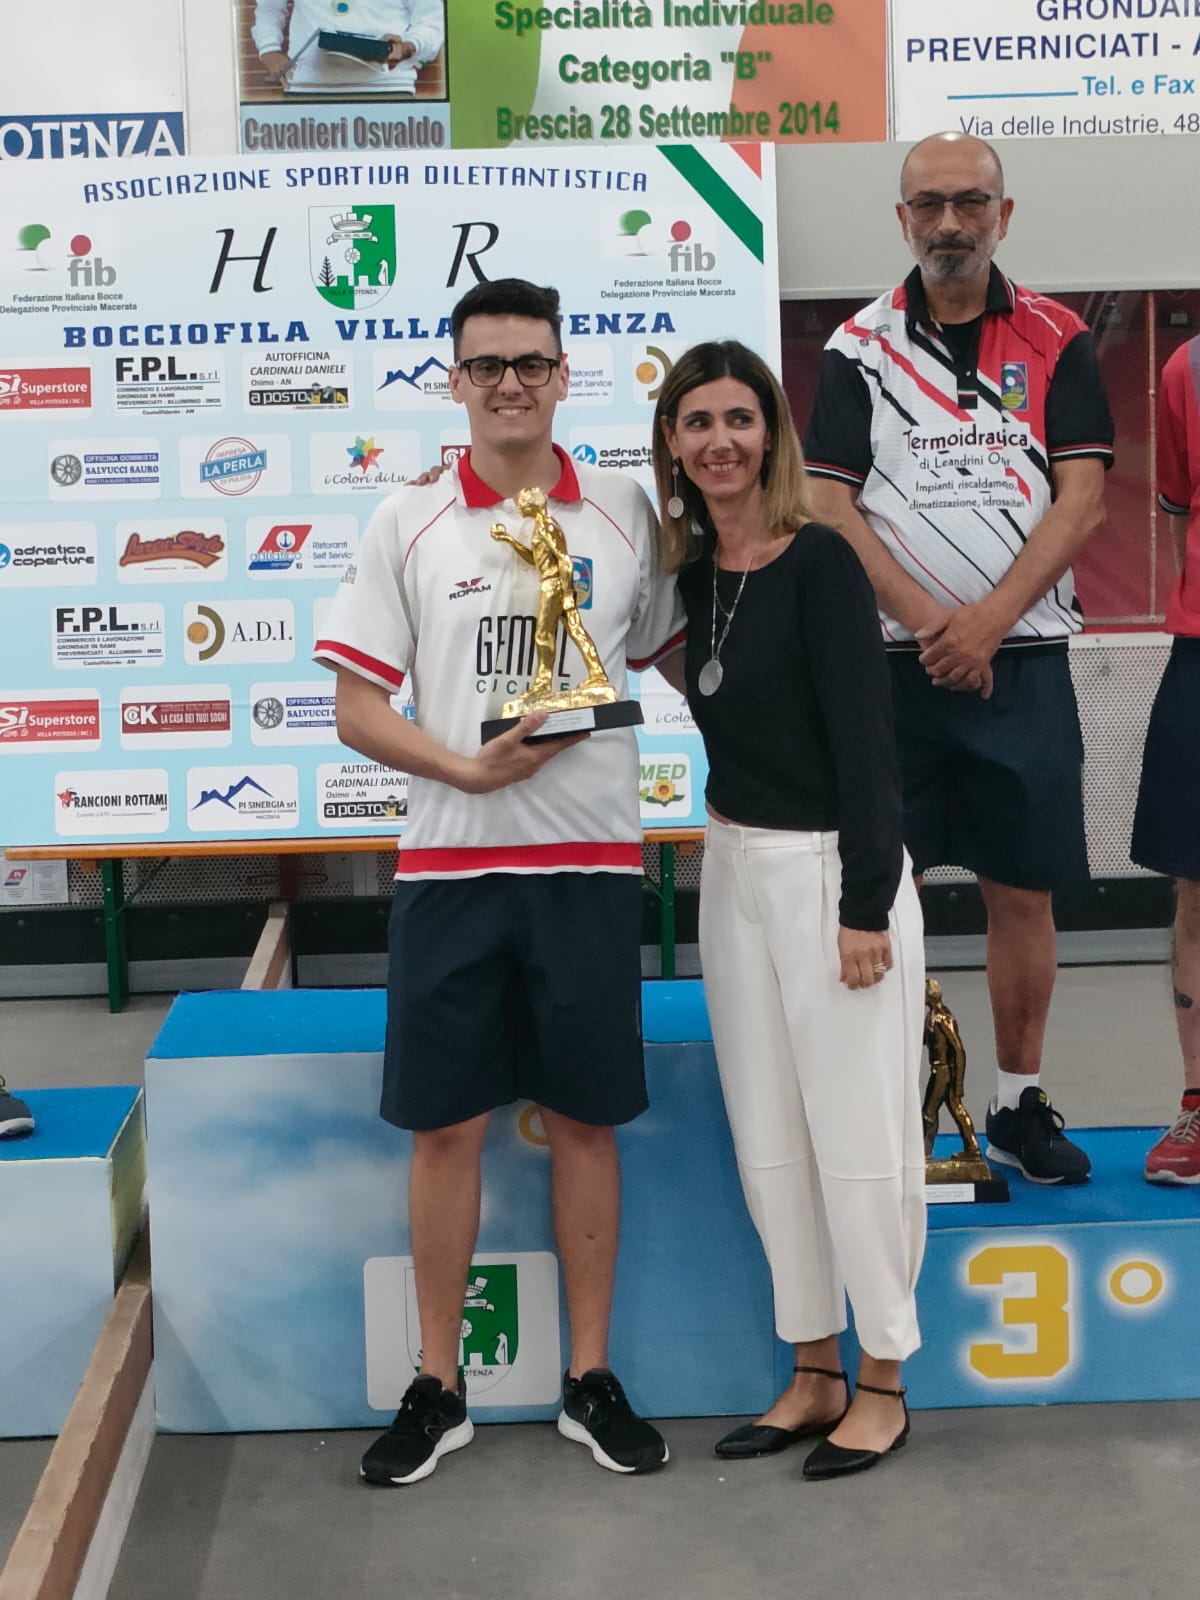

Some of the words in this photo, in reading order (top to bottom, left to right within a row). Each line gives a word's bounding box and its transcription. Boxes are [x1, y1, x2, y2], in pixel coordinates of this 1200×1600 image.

[495, 1, 652, 36] Specialità
[664, 0, 833, 27] Individuale
[906, 32, 1159, 62] PREVERNICIATI
[559, 53, 711, 88] Categoria
[720, 52, 772, 80] "B"
[1082, 76, 1122, 95] Tel.
[1131, 80, 1144, 95] e
[1154, 74, 1195, 94] Fax
[497, 107, 592, 139] Brescia
[600, 106, 631, 138] 28
[639, 103, 770, 137] Settembre
[779, 101, 839, 135] 2014
[960, 116, 994, 136] Via
[1001, 116, 1054, 136] delle
[1063, 113, 1165, 135] Industrie,
[244, 118, 349, 151] Cavalieri
[353, 116, 445, 148] Osvaldo
[84, 169, 271, 204] ASSOCIAZIONE
[286, 165, 409, 188] SPORTIVA
[425, 165, 648, 192] DILETTANTISTICA
[209, 227, 278, 294] H
[446, 222, 499, 288] R
[667, 243, 716, 272] fib
[67, 258, 117, 287] fib
[64, 320, 310, 348] BOCCIOFILA
[335, 318, 453, 341] VILLA
[265, 352, 331, 362] AUTOFFICINA
[250, 366, 302, 376] CARDINALI
[305, 365, 346, 375] DANIELE
[21, 383, 88, 396] Superstore
[204, 464, 221, 477] LA
[223, 455, 263, 474] PERLA
[934, 454, 984, 468] Leandrini
[332, 473, 372, 484] Colori
[915, 481, 954, 494] Impianti
[14, 544, 86, 556] adriatica
[13, 556, 94, 568] coperture
[449, 584, 492, 600] ROPAM
[231, 621, 293, 642] A.D.I.
[28, 714, 96, 728] Superstore
[325, 779, 378, 788] CARDINALI
[125, 794, 167, 806] ROTTAMI
